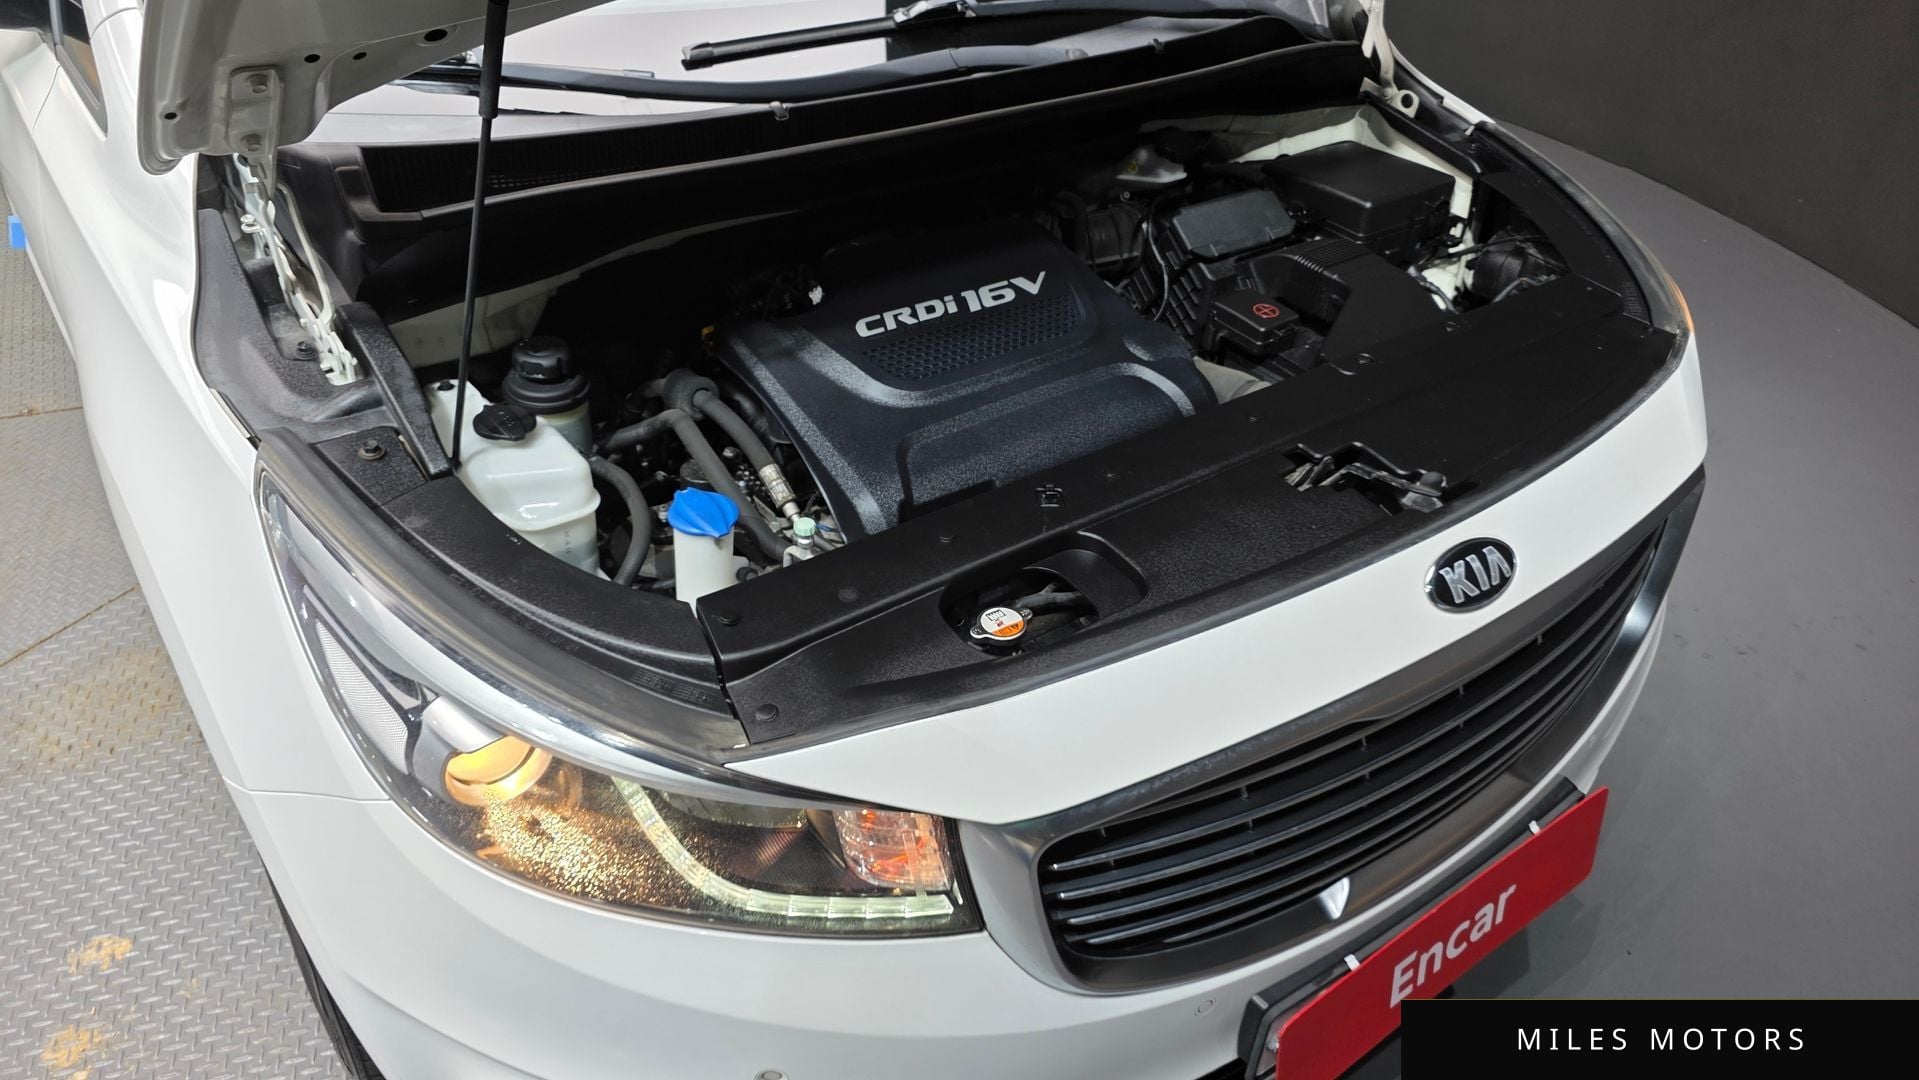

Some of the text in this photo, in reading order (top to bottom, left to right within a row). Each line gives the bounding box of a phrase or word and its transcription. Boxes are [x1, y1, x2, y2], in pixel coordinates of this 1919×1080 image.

[855, 271, 1046, 338] CRDi 16V
[1438, 545, 1512, 604] KIA
[1389, 884, 1517, 1009] Encar
